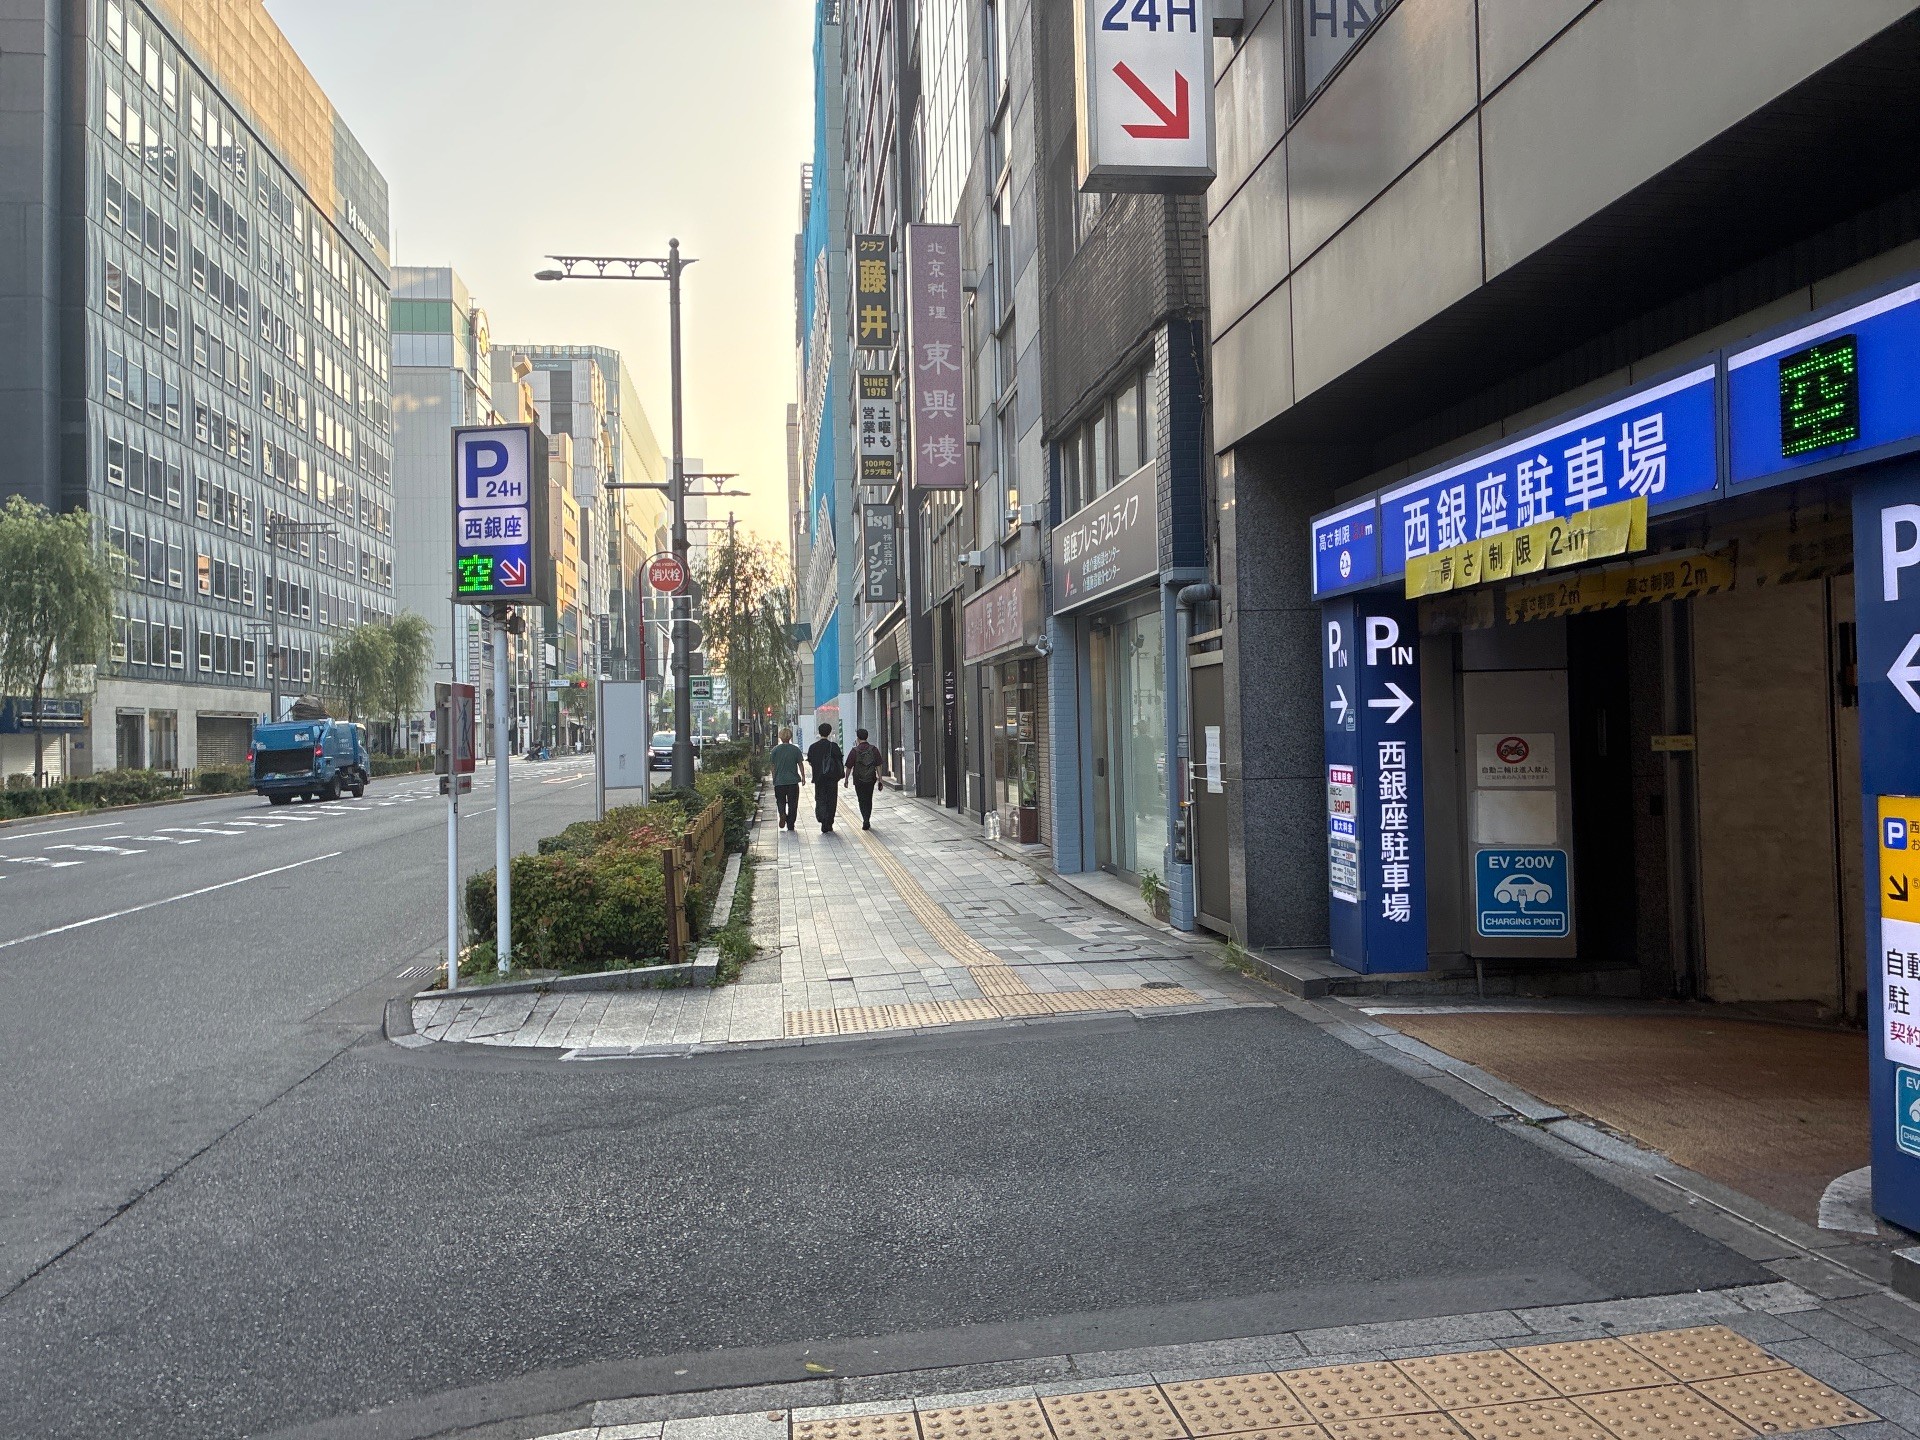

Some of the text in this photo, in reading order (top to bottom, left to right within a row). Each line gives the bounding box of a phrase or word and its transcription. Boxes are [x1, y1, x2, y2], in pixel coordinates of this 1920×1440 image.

[1101, 0, 1197, 32] 24H
[860, 240, 885, 252] クラブ
[859, 259, 888, 339] 藤井
[927, 242, 948, 319] 北京料理
[864, 377, 889, 387] SINCE
[866, 387, 887, 397] 1976
[1780, 347, 1856, 456] 空
[862, 406, 876, 448] 営業中
[878, 406, 892, 448] 土曜も
[465, 440, 522, 499] P 24H
[864, 460, 892, 468] 100坪の
[864, 468, 893, 476] クラブ藤井
[1402, 411, 1668, 559] 西銀座駐車場
[464, 514, 523, 540] 西銀座
[1063, 494, 1139, 566] 銀座プレミアムライフ
[1319, 524, 1351, 552] 高さ制限
[882, 533, 894, 566] 株式会社
[1439, 526, 1586, 584] 高さ制限 2m
[458, 554, 494, 592] 空
[652, 568, 681, 582] 消火栓
[868, 541, 888, 597] イシグロ
[1328, 620, 1348, 669] P IN
[1365, 616, 1413, 666] P IN
[1377, 740, 1411, 923] 西銀座駐車場
[1488, 855, 1555, 869] EV 200V
[1485, 917, 1560, 926] CHARGING POINT
[1888, 984, 1911, 1016] 駐
